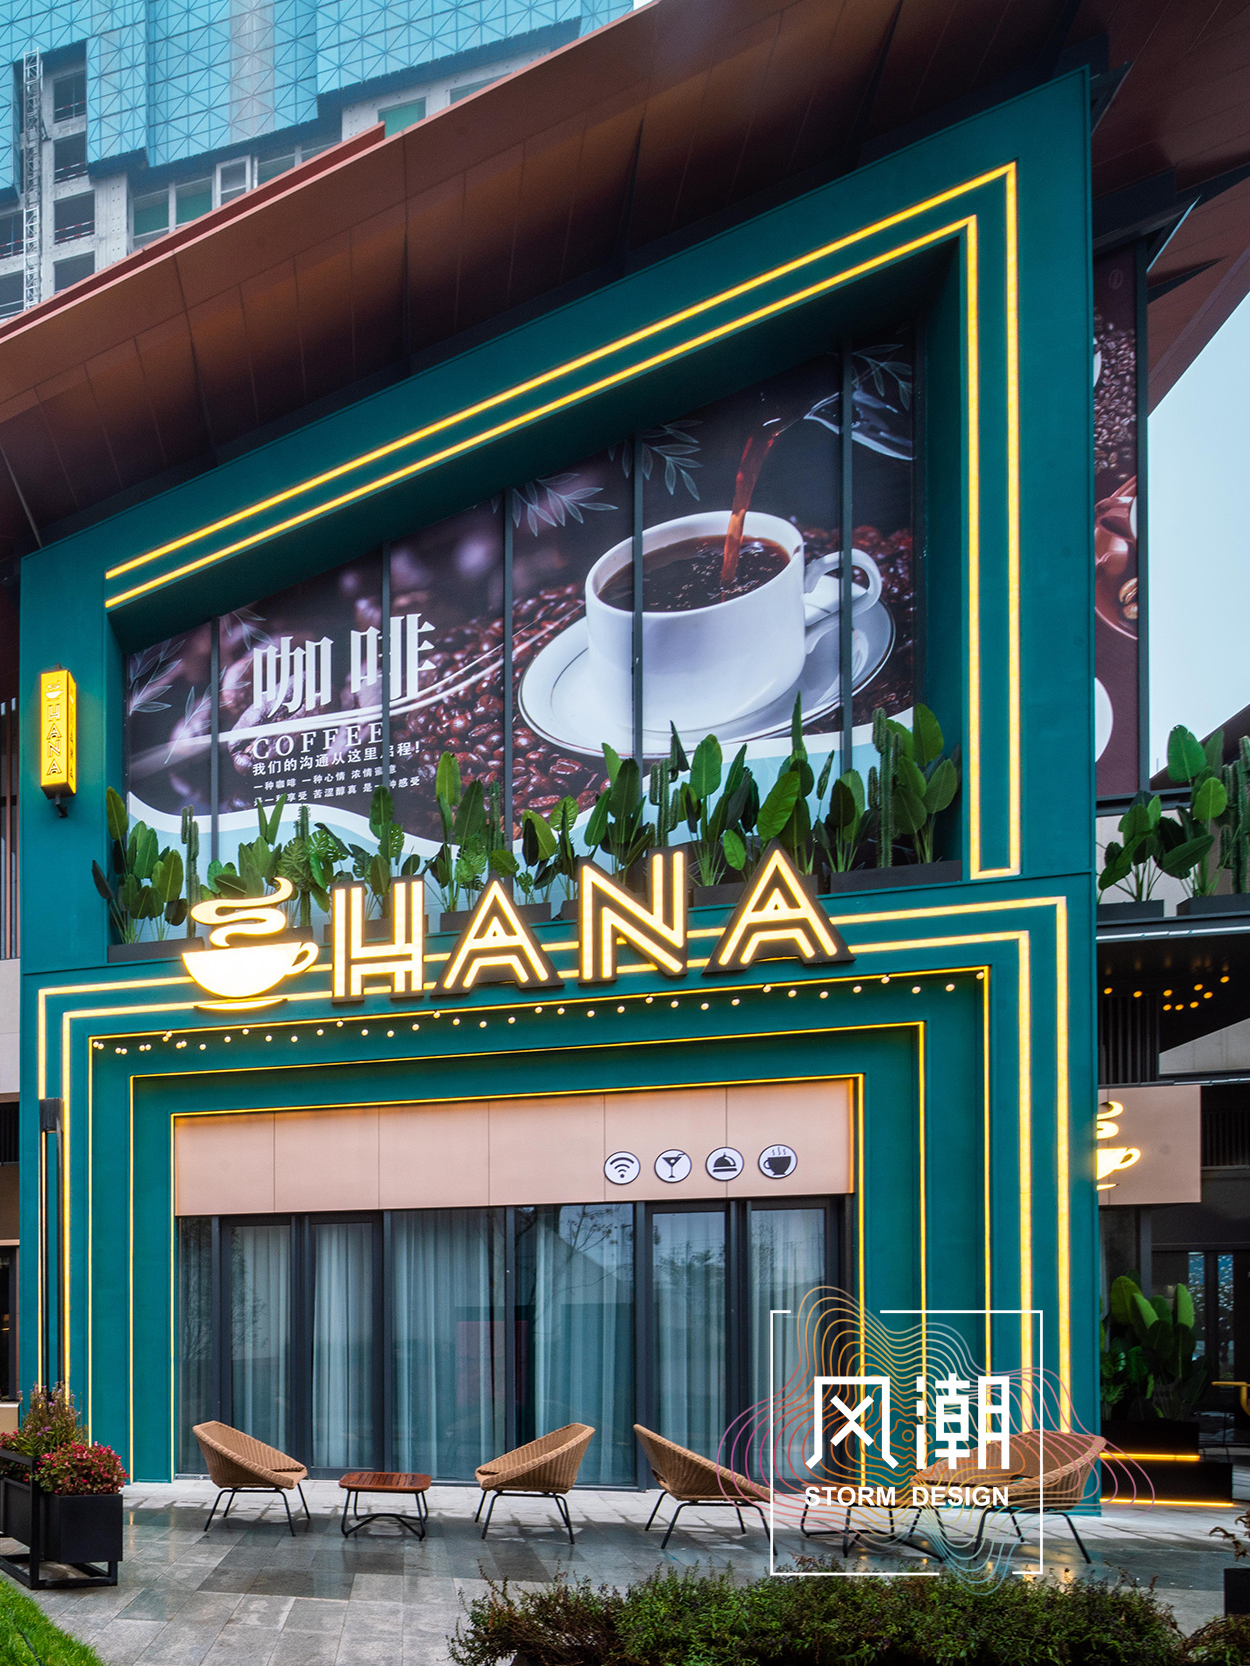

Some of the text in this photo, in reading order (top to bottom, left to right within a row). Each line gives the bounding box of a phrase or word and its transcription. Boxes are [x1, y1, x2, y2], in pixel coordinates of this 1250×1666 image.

[252, 613, 436, 718] 咖啡
[46, 703, 63, 776] HANA
[252, 722, 384, 760] COFFEE
[301, 771, 346, 785] 一种心情
[332, 838, 855, 1003] HANA
